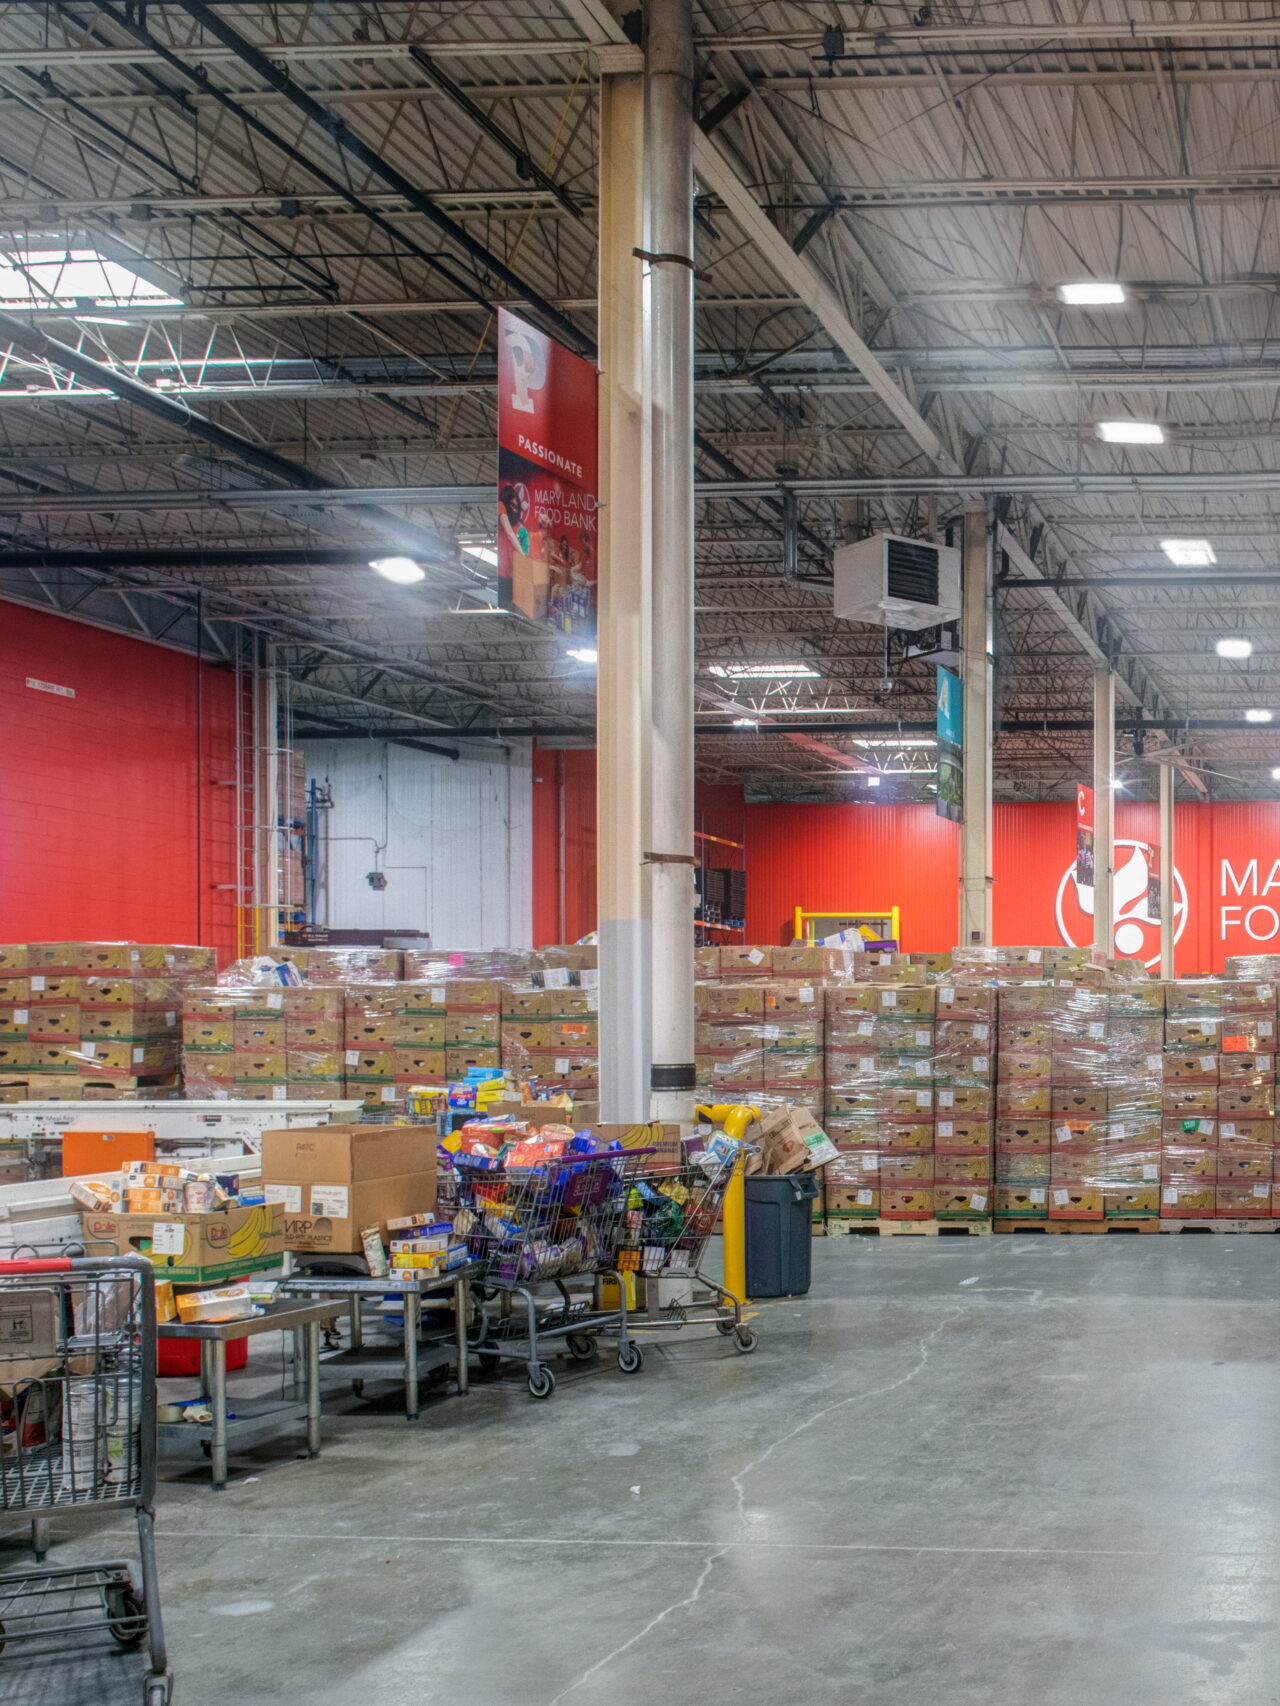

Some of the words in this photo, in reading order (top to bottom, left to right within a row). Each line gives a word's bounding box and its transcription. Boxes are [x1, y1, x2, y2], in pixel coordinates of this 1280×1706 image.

[518, 434, 583, 479] PASSIONATE
[534, 488, 597, 512] MARYLAND
[534, 506, 562, 525] FOOD
[563, 510, 597, 532] BANK
[93, 1221, 116, 1233] Dole
[210, 1226, 228, 1240] Dole
